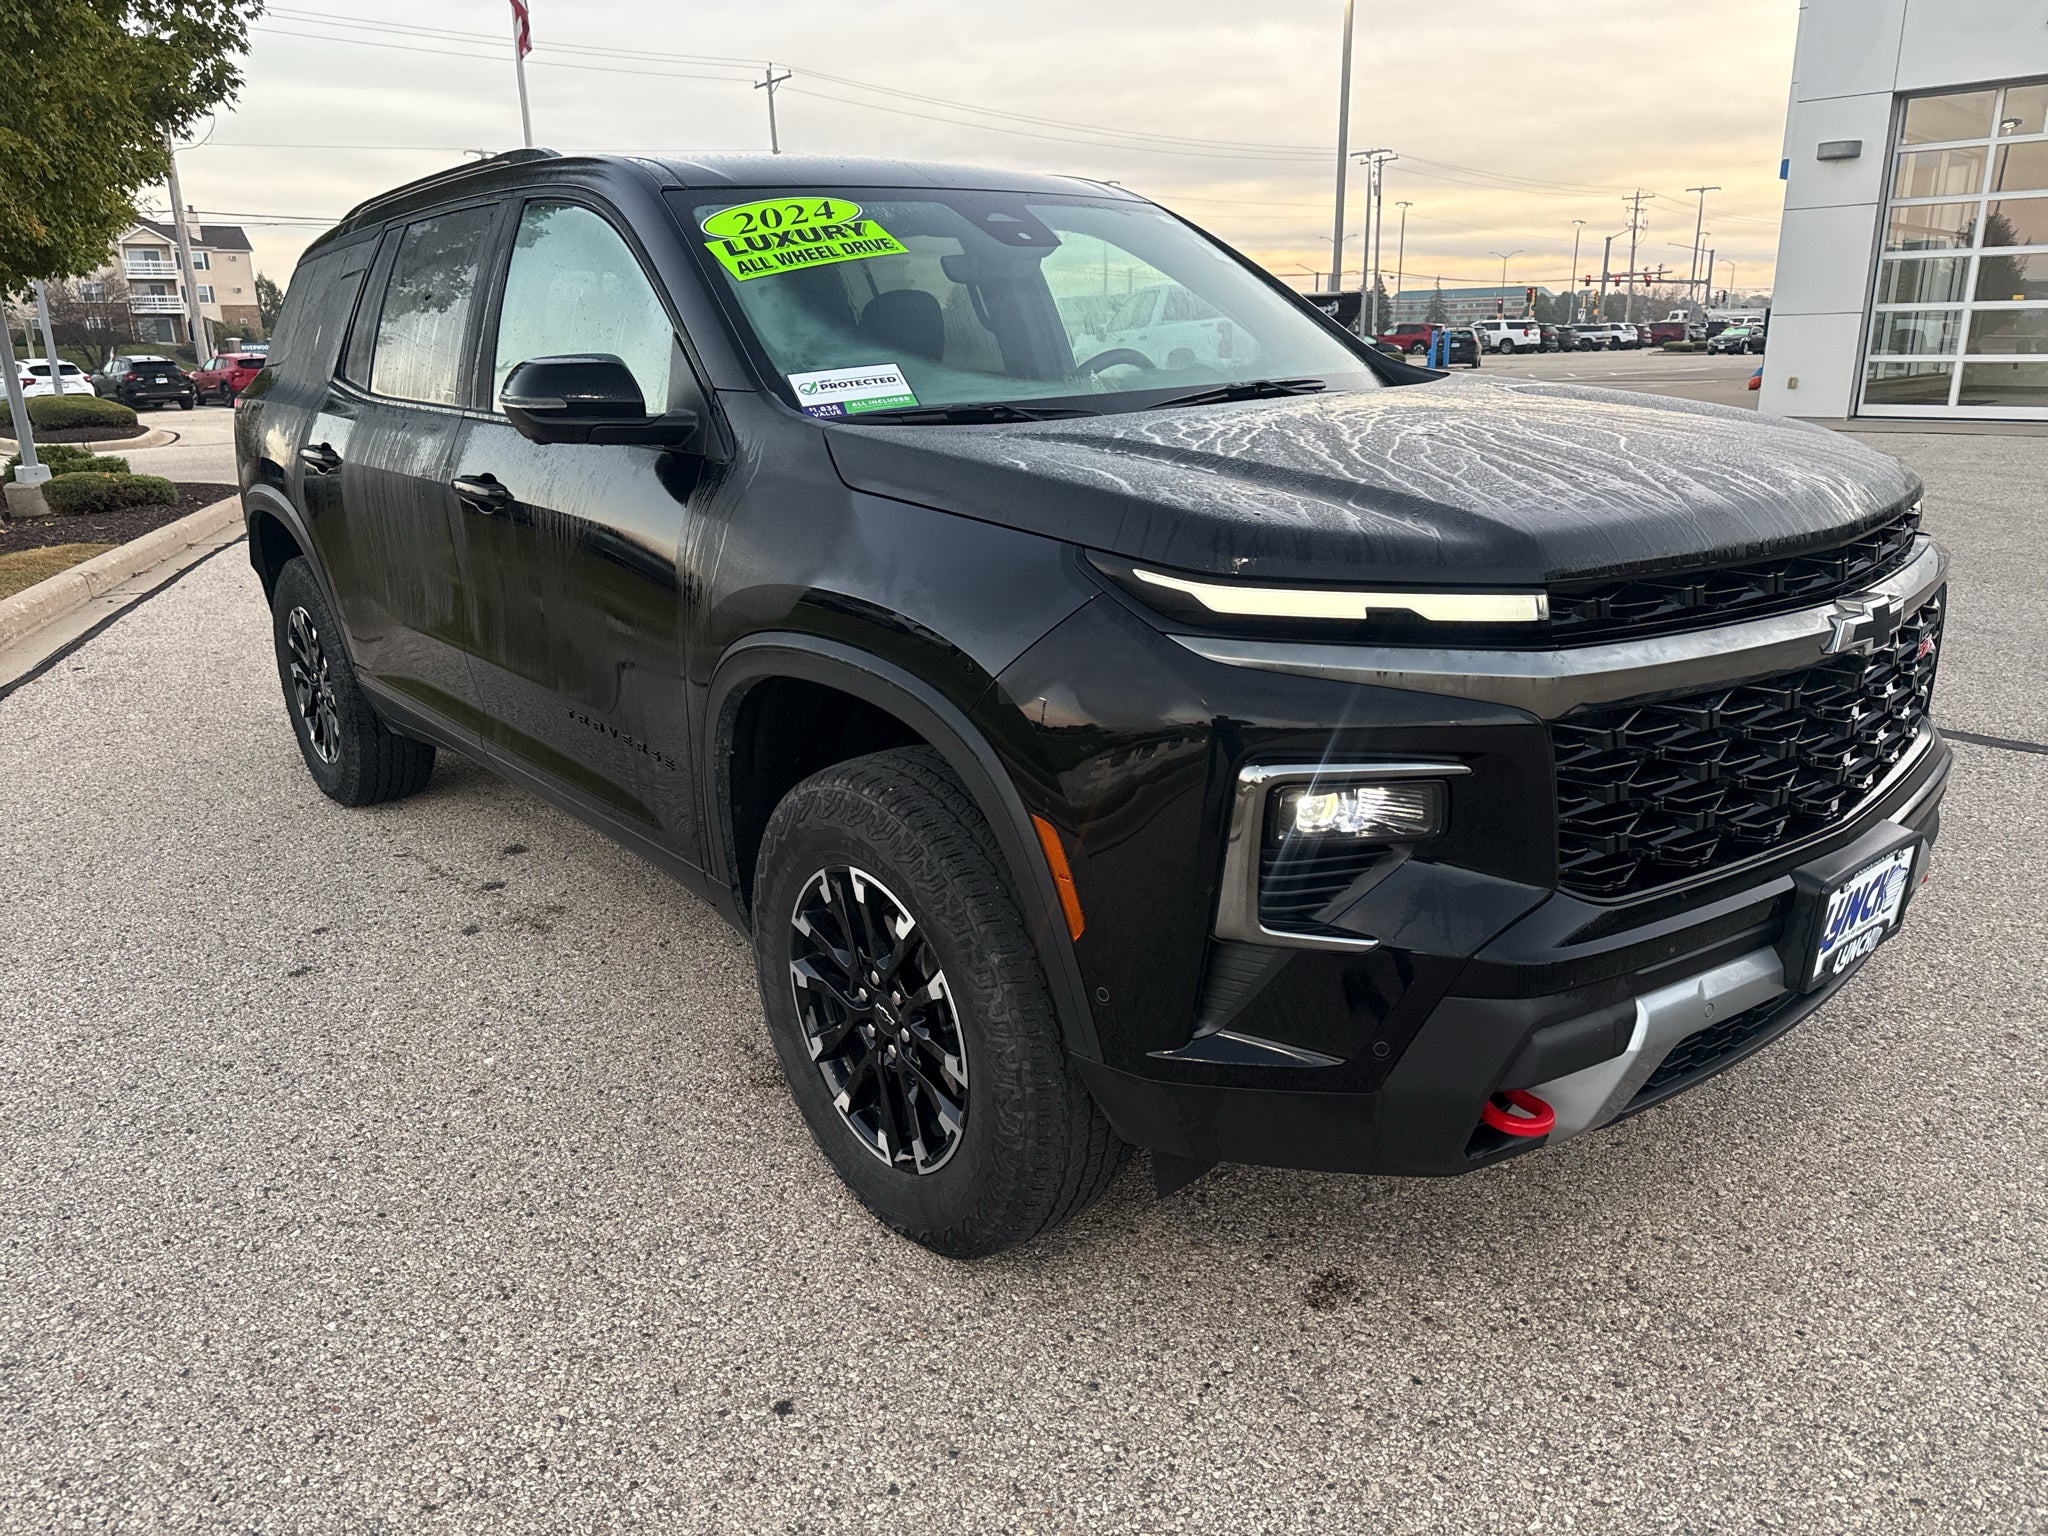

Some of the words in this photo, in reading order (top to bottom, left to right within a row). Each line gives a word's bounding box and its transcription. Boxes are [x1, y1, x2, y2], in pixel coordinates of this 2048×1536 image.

[733, 200, 835, 235] 2024
[723, 221, 866, 257] LUXURY
[736, 256, 775, 276] ALL
[773, 247, 839, 267] WHEEL
[838, 238, 895, 255] DRIVE
[819, 376, 897, 391] PROTECTED
[812, 409, 843, 418] VALUE
[851, 400, 867, 408] ALL
[868, 396, 911, 405] INCLUDED
[563, 706, 676, 771] TRAVERSE
